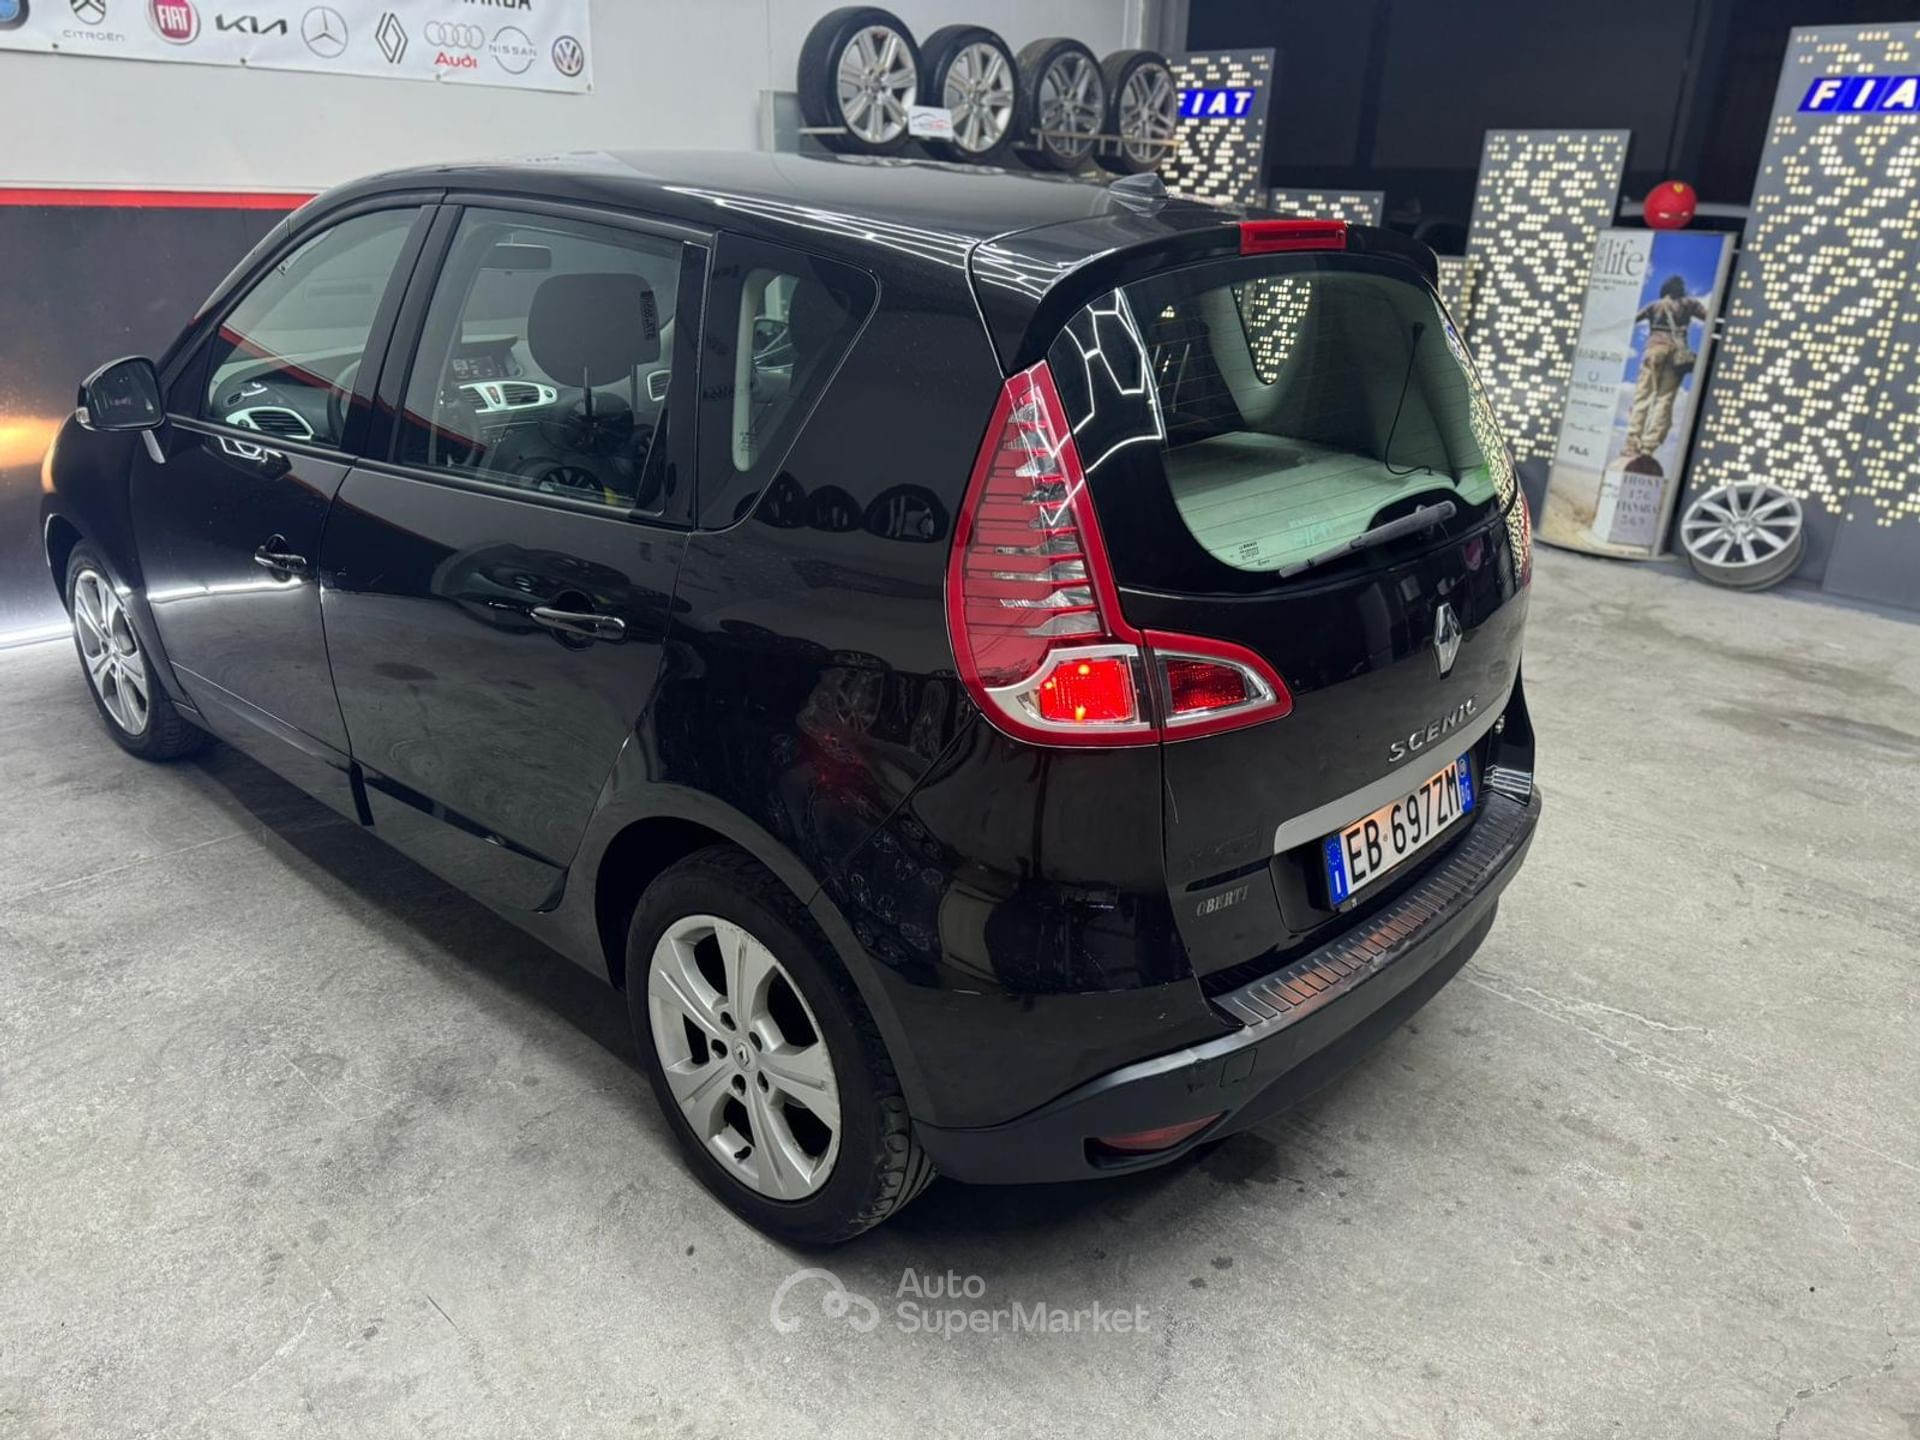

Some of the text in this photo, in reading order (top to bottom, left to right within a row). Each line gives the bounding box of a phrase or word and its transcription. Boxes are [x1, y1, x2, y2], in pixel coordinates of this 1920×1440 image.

[156, 4, 190, 31] FIAT
[215, 13, 288, 36] KIA
[434, 51, 478, 69] Audi
[488, 44, 537, 57] NISSAN
[1603, 238, 1645, 277] life
[1388, 694, 1479, 762] SCENIC
[1345, 763, 1461, 885] EB 697ZM
